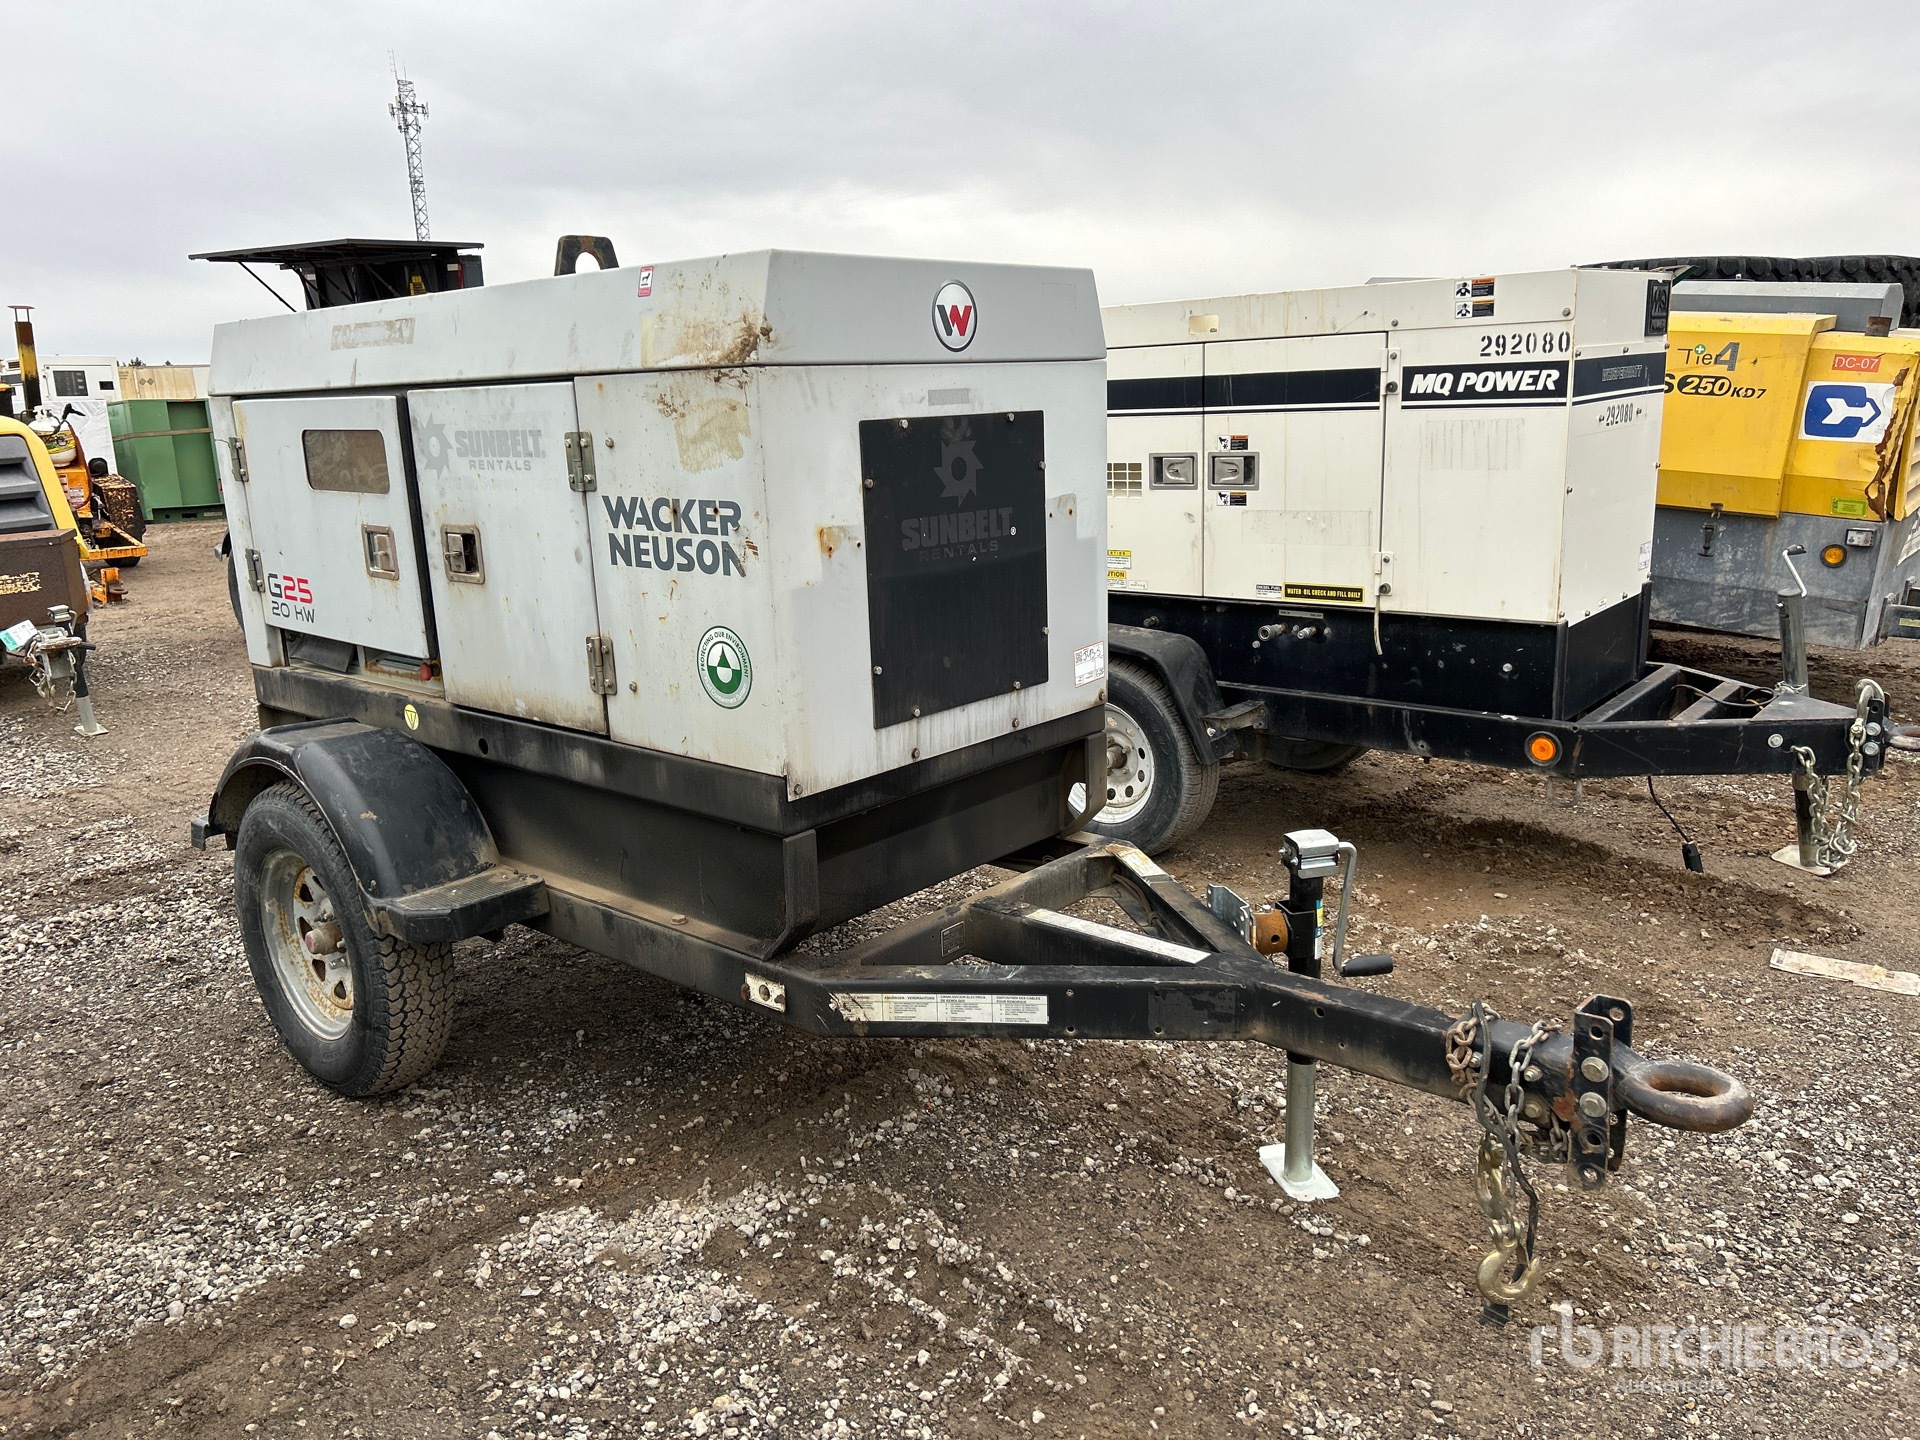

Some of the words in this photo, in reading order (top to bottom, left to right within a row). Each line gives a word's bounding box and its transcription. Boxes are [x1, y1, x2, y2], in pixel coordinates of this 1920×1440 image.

[936, 304, 973, 337] W
[1480, 331, 1571, 357] 292080
[1834, 356, 1879, 370] DC-07
[1410, 372, 1454, 397] MQ
[1456, 369, 1560, 393] POWER
[1682, 377, 1731, 396] 250
[1605, 403, 1634, 427] 292080
[454, 429, 543, 458] SUNBELT
[469, 459, 532, 471] RENTALS
[601, 495, 743, 537] WACKER
[901, 506, 1013, 550] SUNBELT
[608, 532, 747, 578] NEUSON
[920, 540, 998, 561] RENTALS
[267, 573, 313, 604] G25
[1337, 590, 1347, 598] FILL
[271, 600, 290, 618] 20
[700, 634, 714, 671] PROTECTING
[725, 632, 749, 678] ENVIRONMENT
